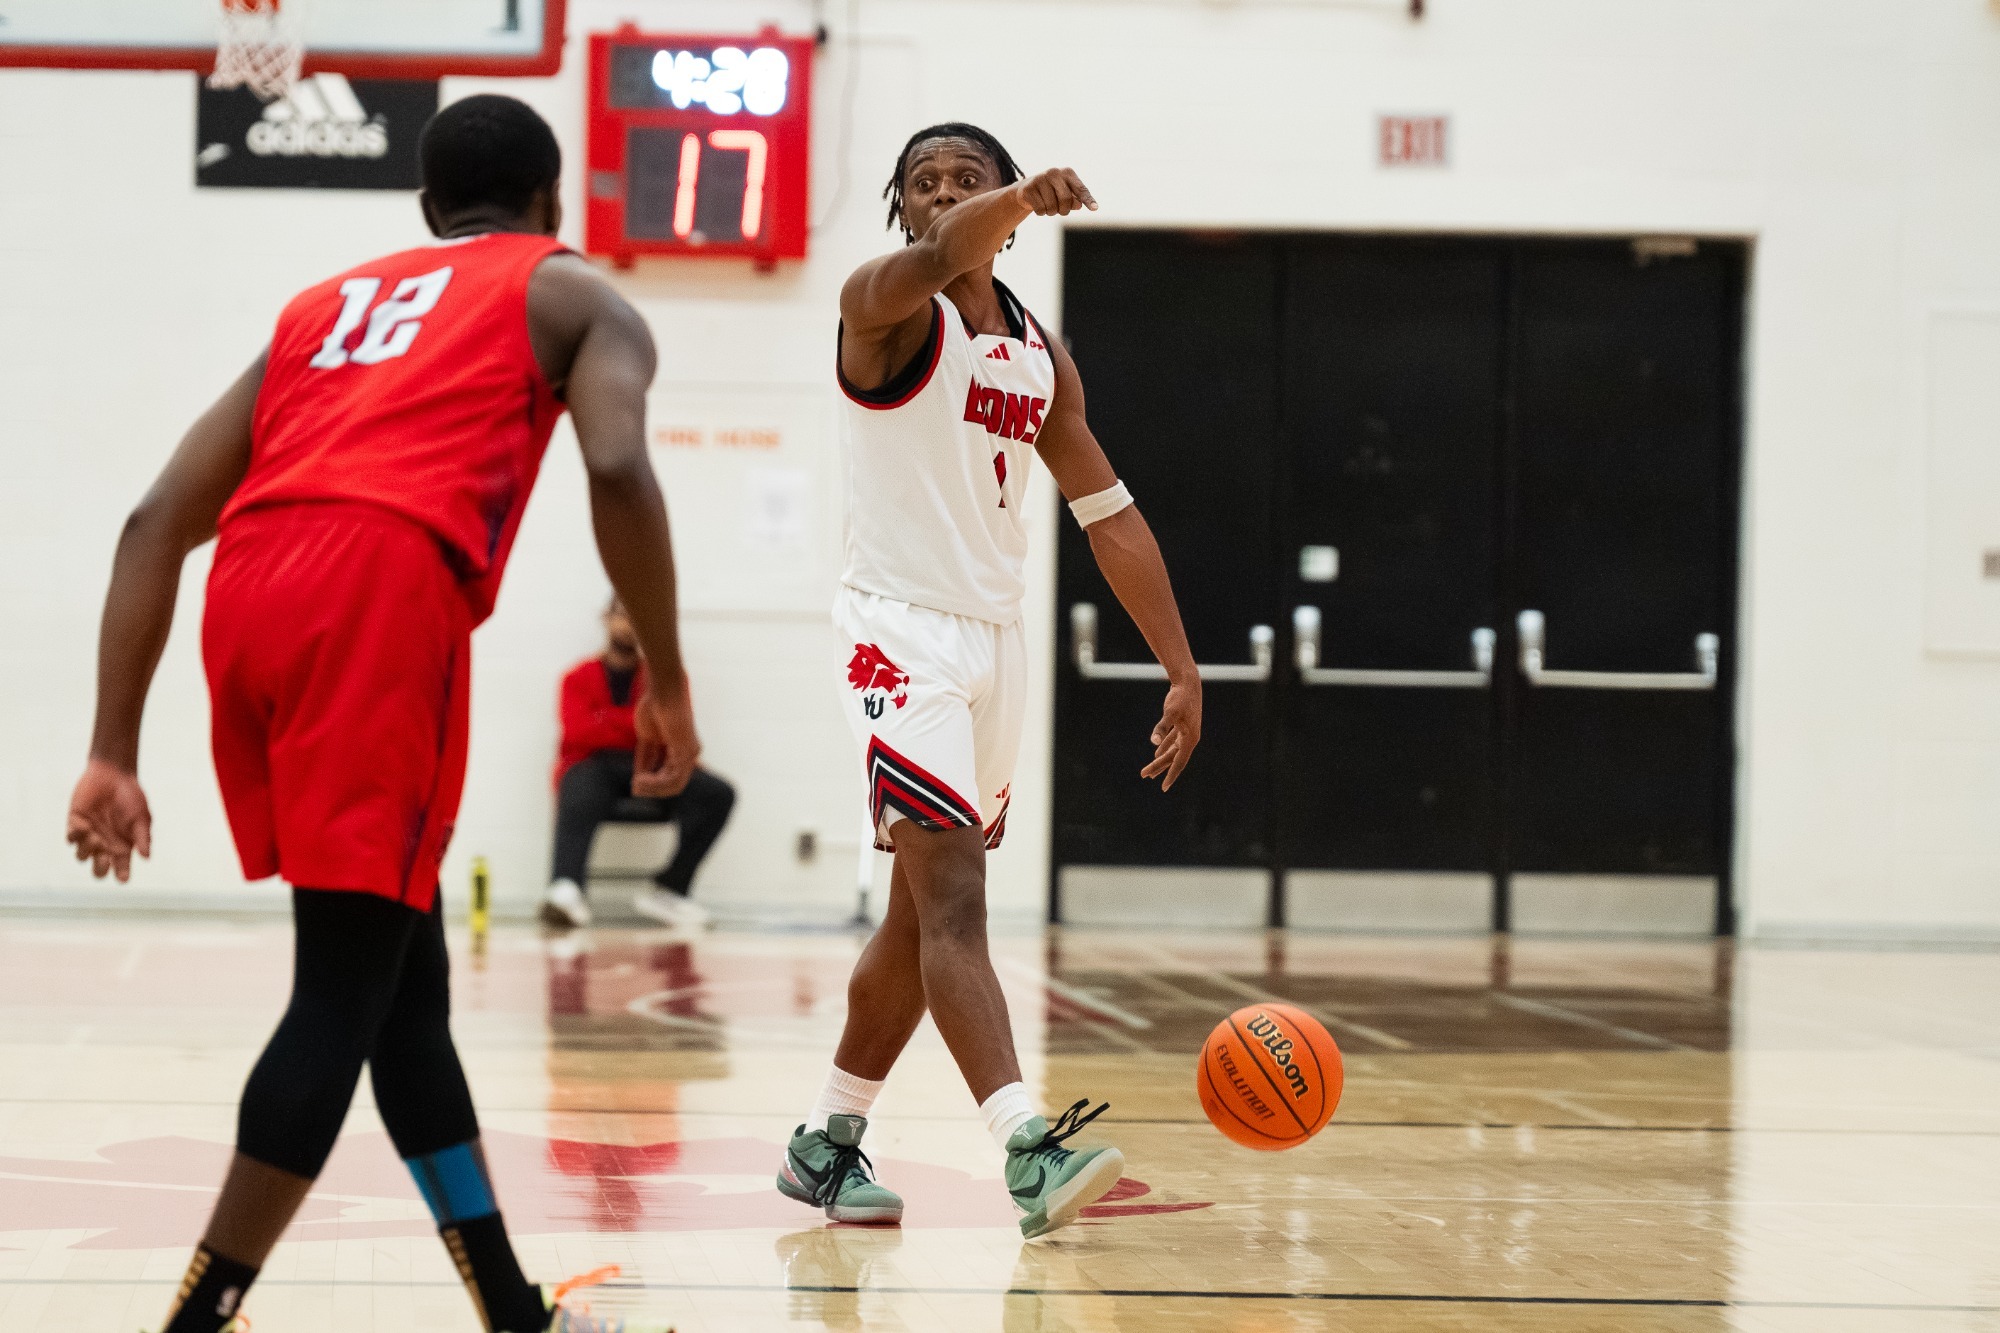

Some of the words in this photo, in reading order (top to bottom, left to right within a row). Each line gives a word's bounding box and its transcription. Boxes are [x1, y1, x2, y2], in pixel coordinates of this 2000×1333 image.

[652, 47, 788, 115] 4:28
[246, 120, 388, 157] adidas
[1379, 115, 1446, 164] EXIT
[674, 130, 769, 241] 17
[309, 265, 454, 370] 12
[993, 450, 1007, 508] 1
[863, 693, 885, 720] YU
[1216, 1044, 1276, 1121] EVOLUTION
[1246, 1012, 1309, 1099] Wilson
